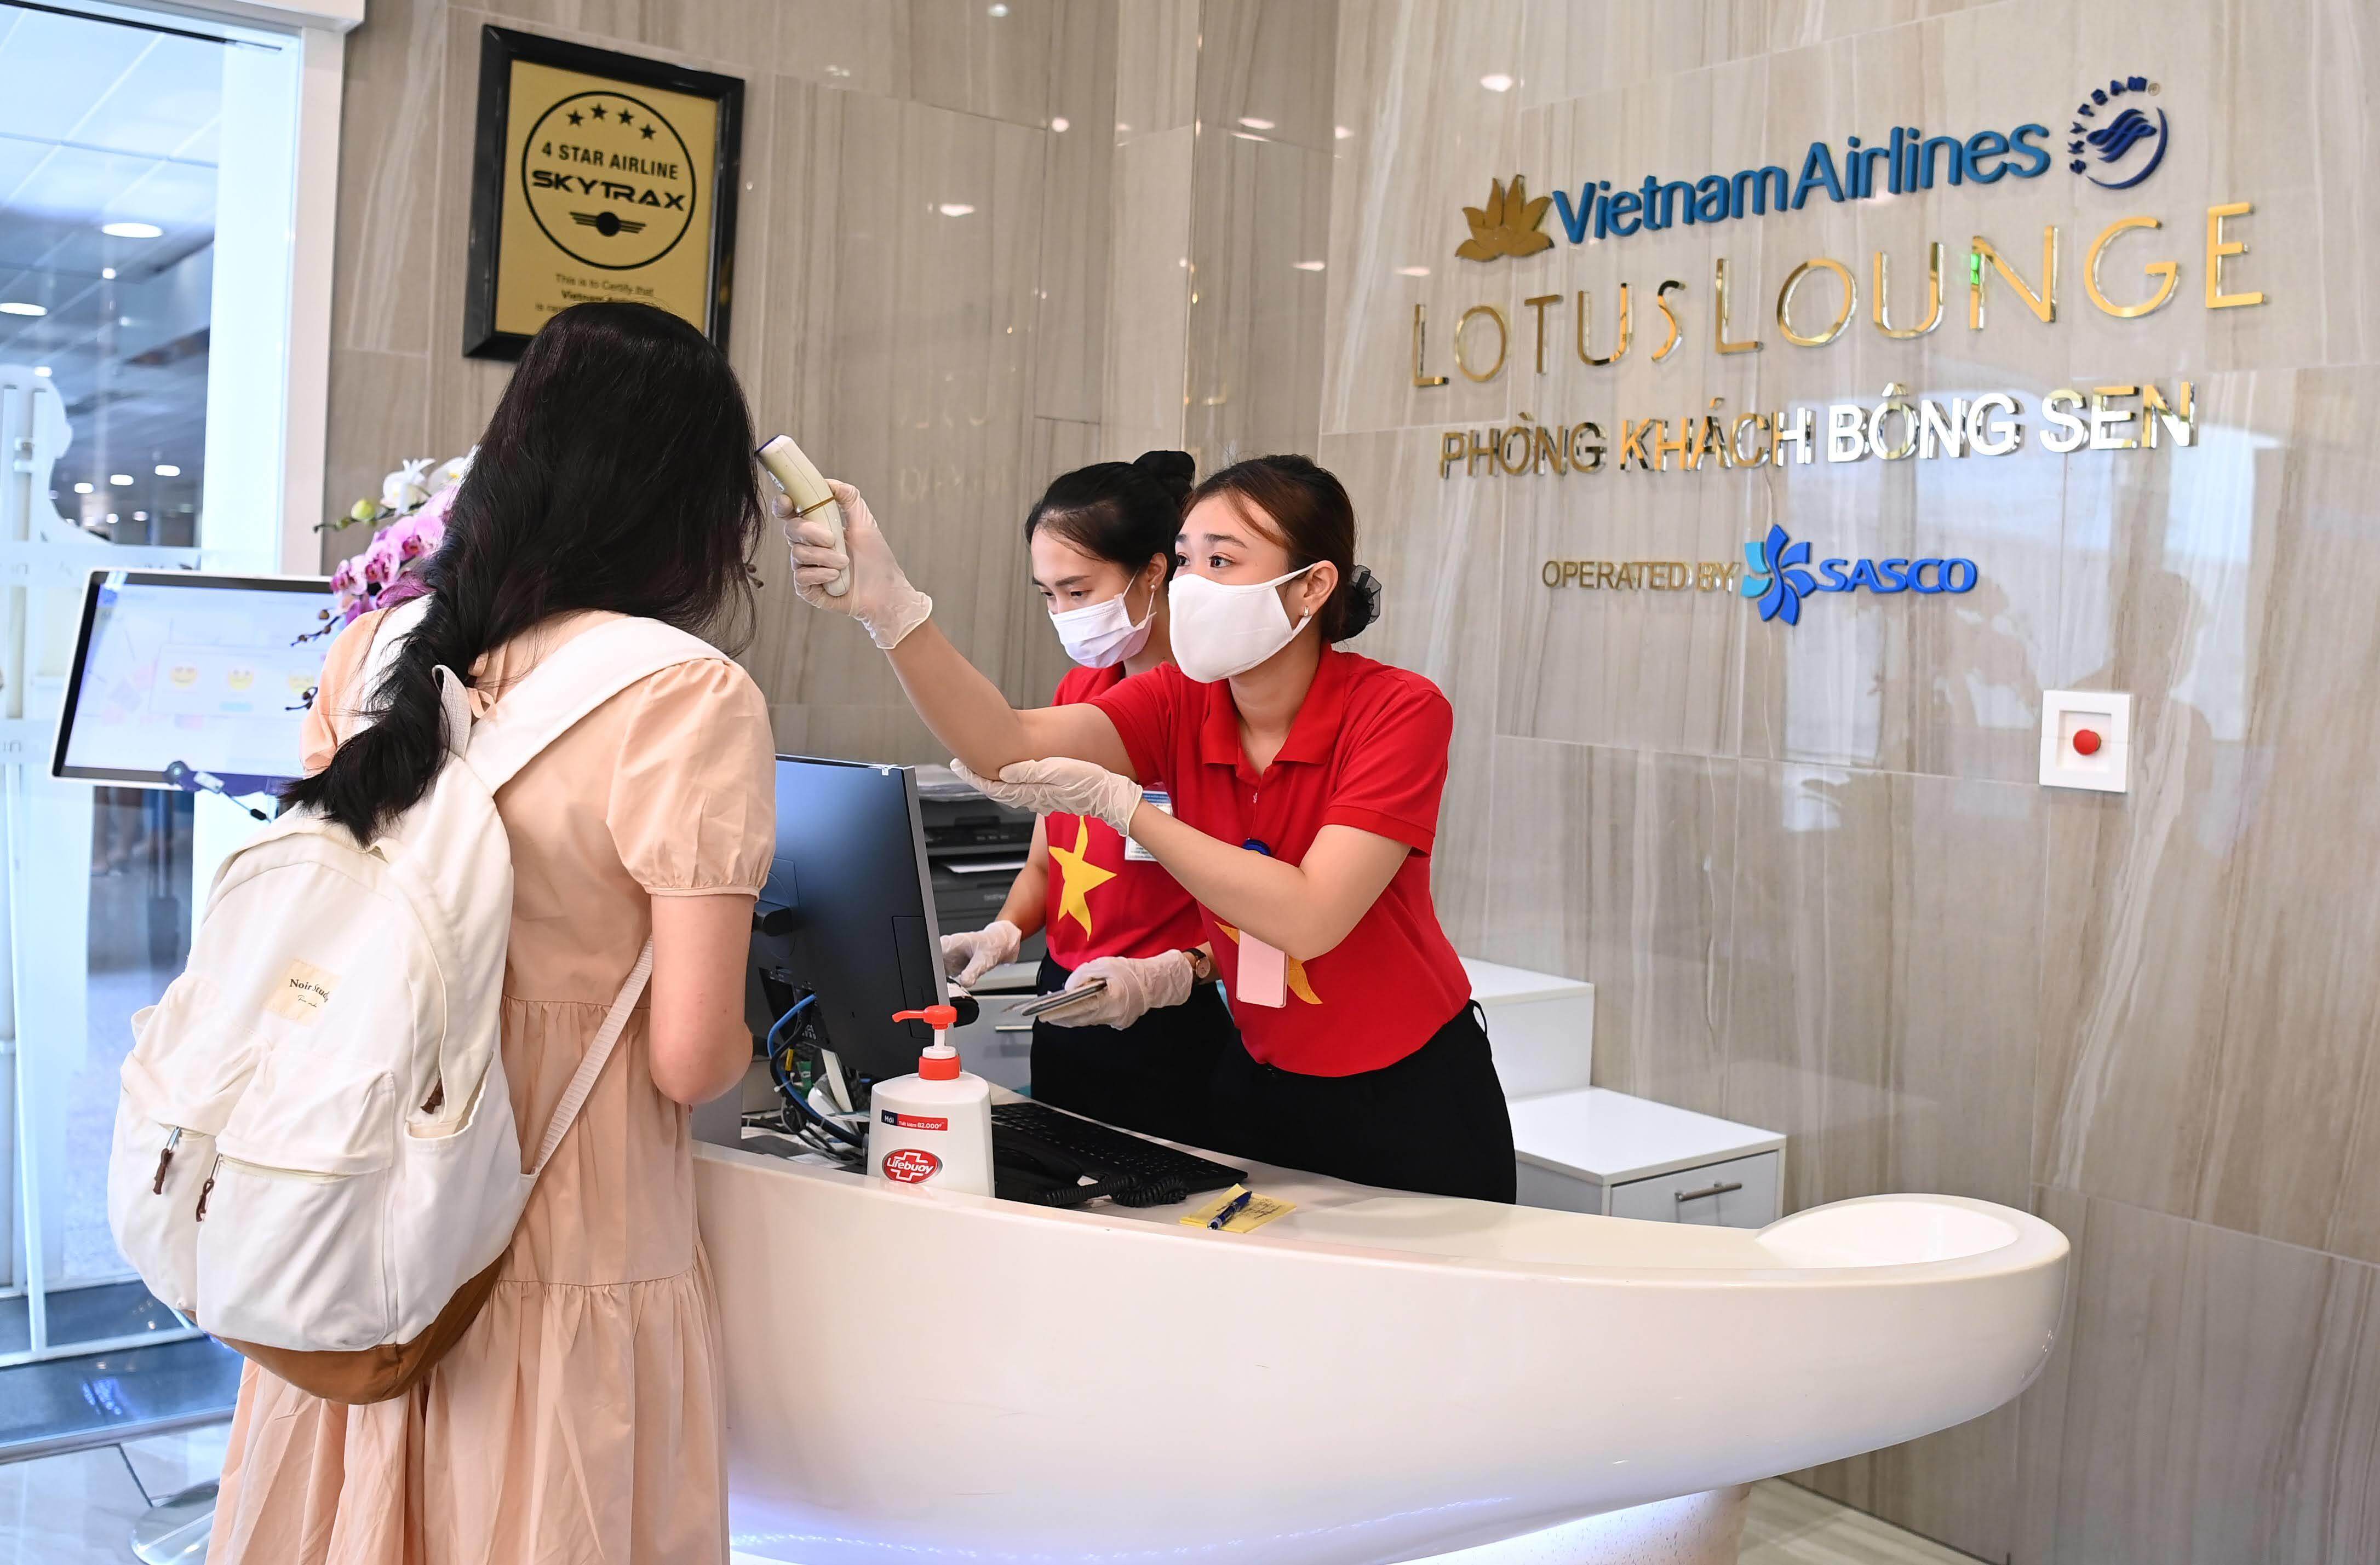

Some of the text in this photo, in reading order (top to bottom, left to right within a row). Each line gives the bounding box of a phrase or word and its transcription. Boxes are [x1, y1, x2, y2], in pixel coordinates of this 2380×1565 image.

[542, 140, 679, 180] 4 STAR AIRLINE
[532, 169, 686, 211] SKYTRAX
[1412, 202, 2266, 387] LOTUS LOUNGE
[1440, 381, 2198, 479] PHÒNG KHÁCH BÔNG SEN
[1541, 559, 1741, 593] OPERATED BY
[1814, 557, 1978, 594] SASCO
[290, 979, 312, 990] Noir
[886, 1157, 934, 1175] Lifebuoy
